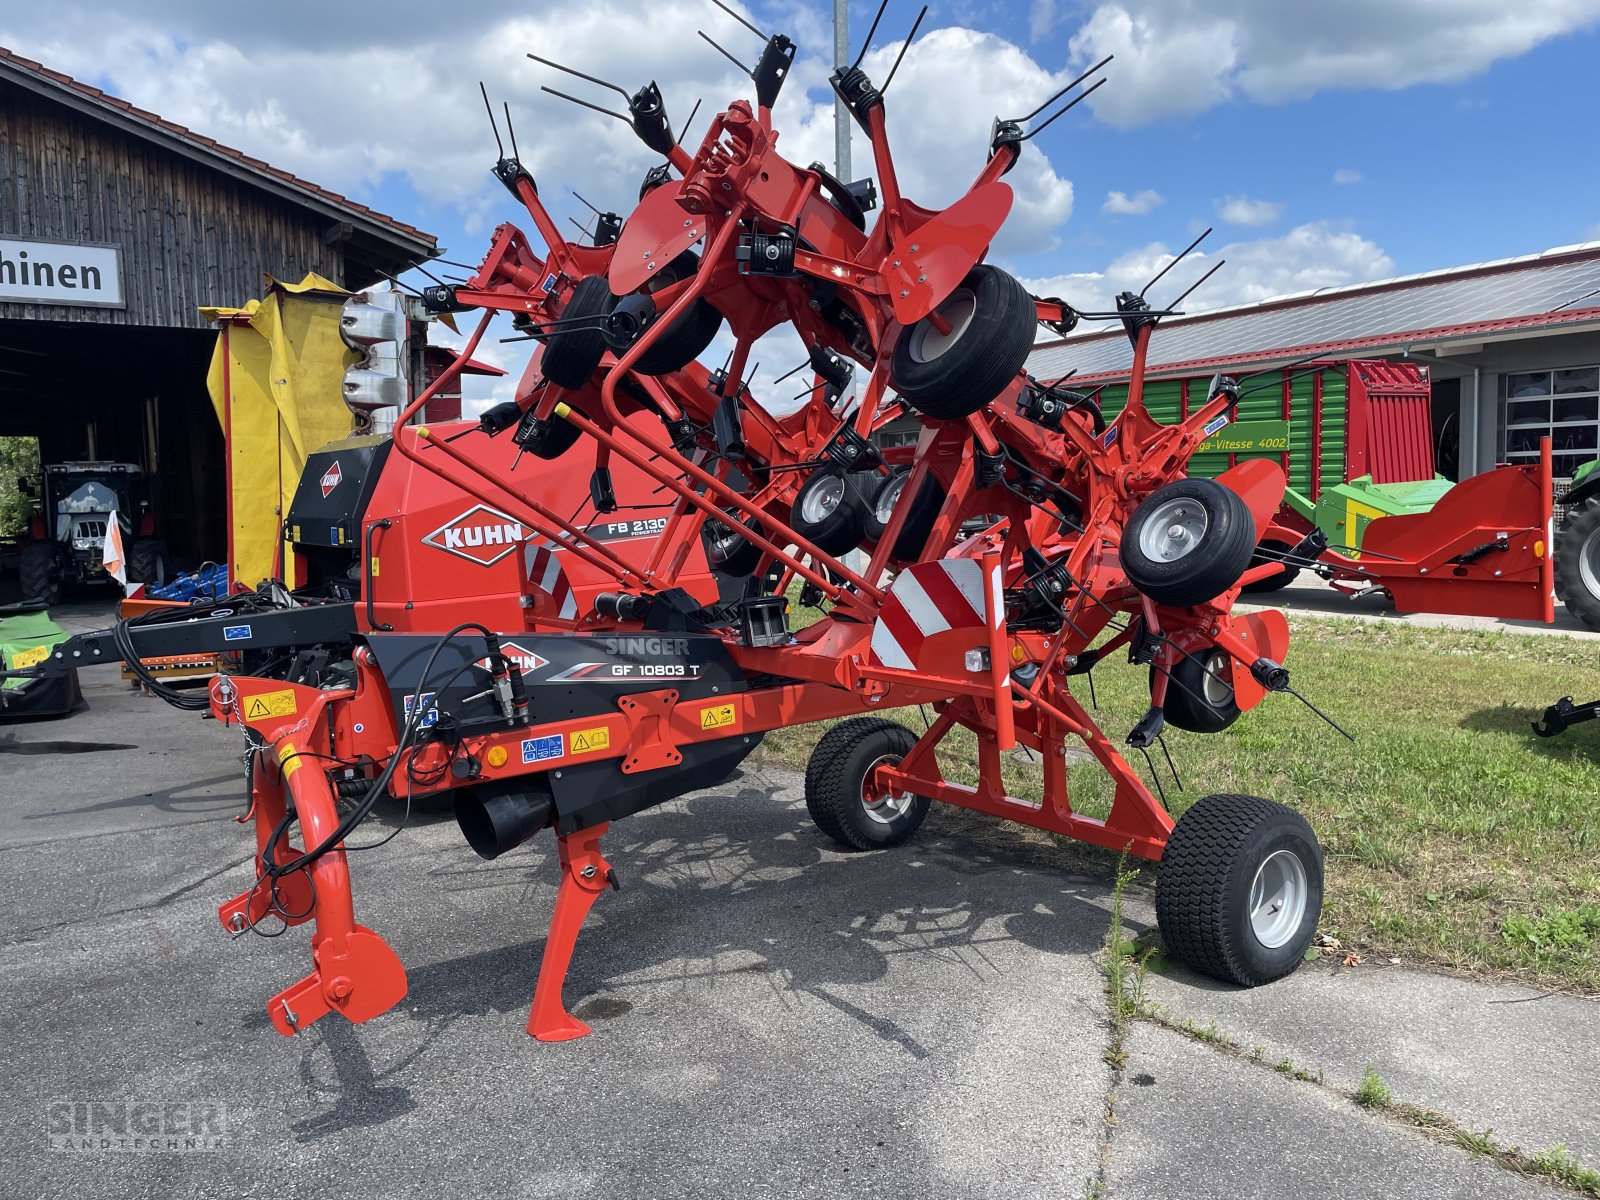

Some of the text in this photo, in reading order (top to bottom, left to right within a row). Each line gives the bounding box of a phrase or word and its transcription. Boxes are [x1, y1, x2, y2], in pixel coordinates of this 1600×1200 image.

[1196, 438, 1287, 452] ga-Vitesse 4002
[608, 518, 667, 534] FB 2130
[444, 523, 522, 548] KUHN
[606, 638, 690, 655] SINGER
[484, 656, 536, 669] KHN
[612, 665, 700, 675] GF 10803 T
